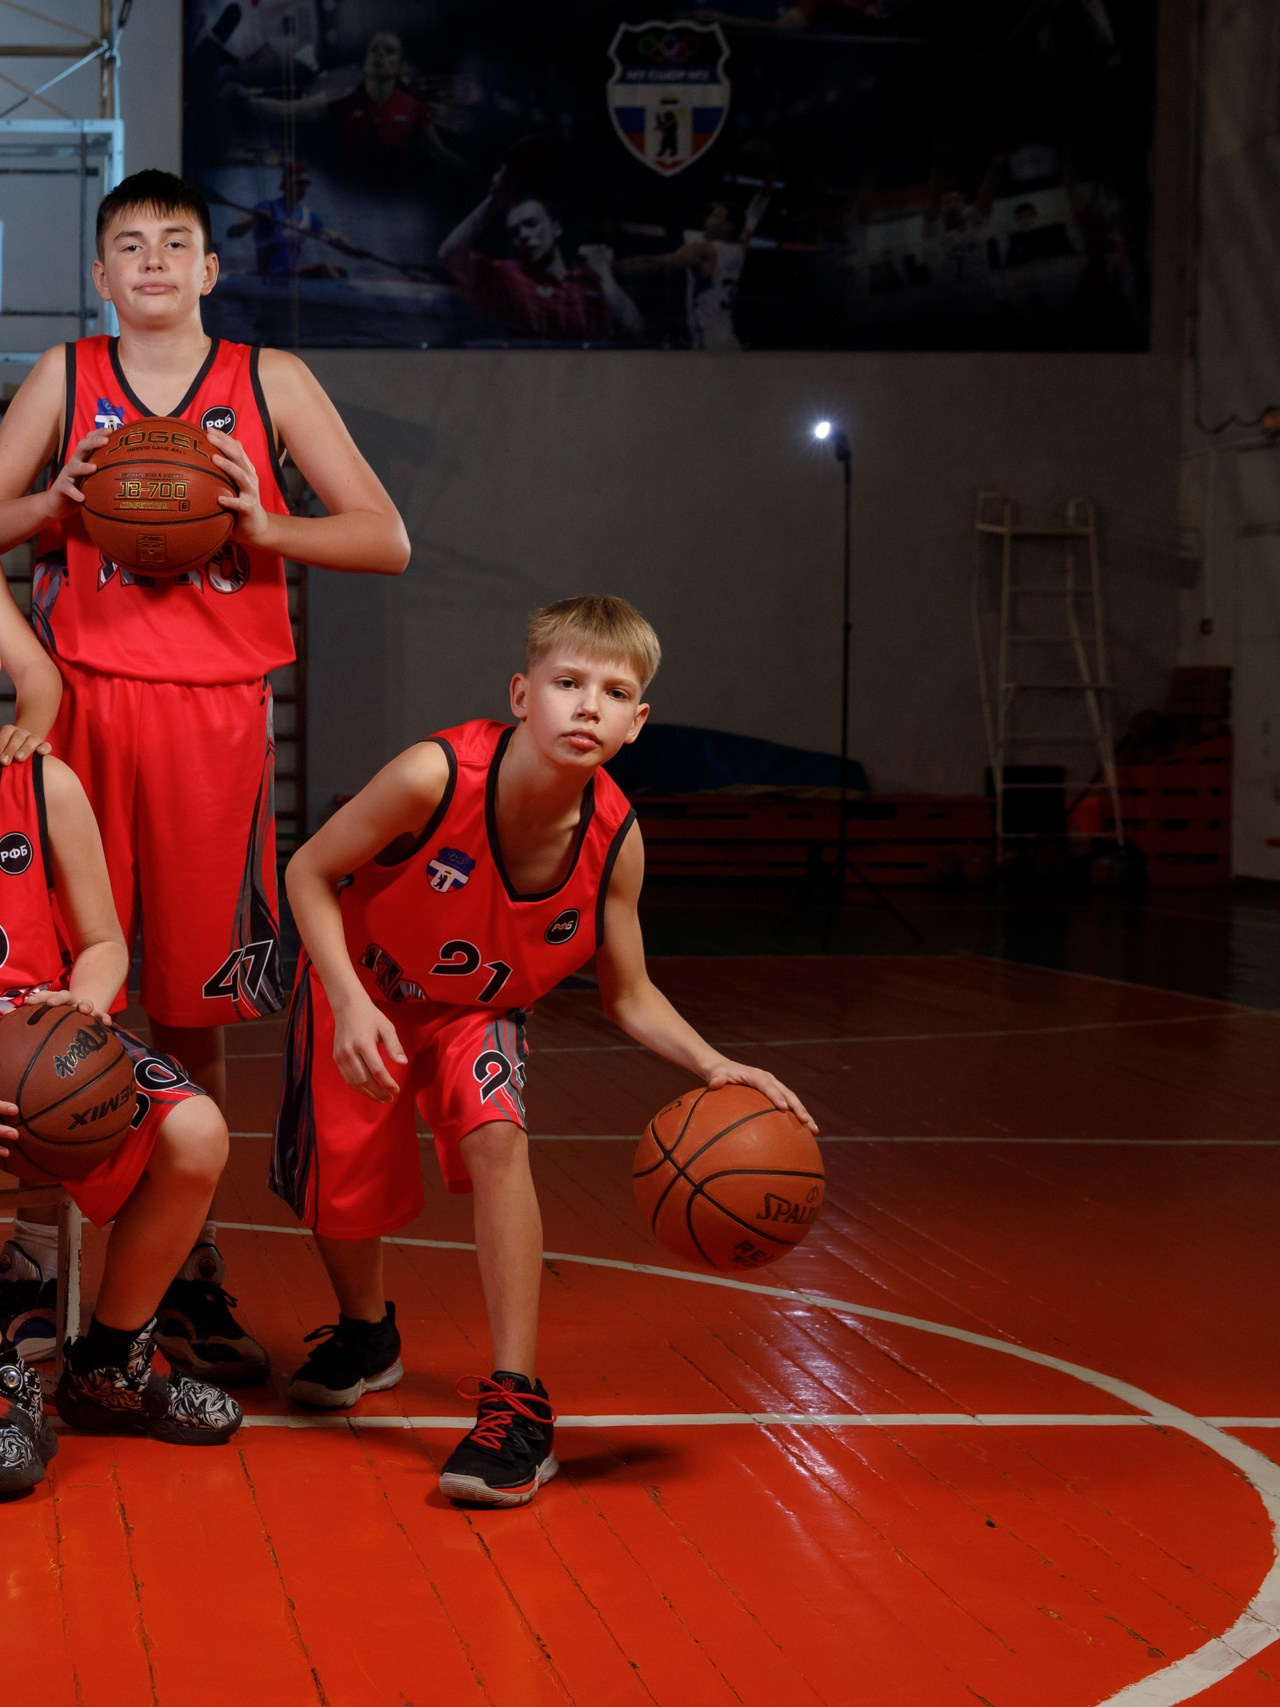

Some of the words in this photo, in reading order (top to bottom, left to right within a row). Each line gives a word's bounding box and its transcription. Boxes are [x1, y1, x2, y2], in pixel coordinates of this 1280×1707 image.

[206, 414, 231, 429] РФБ
[116, 481, 187, 499] JB-700
[0, 845, 28, 862] РФБ
[202, 939, 274, 1003] 47
